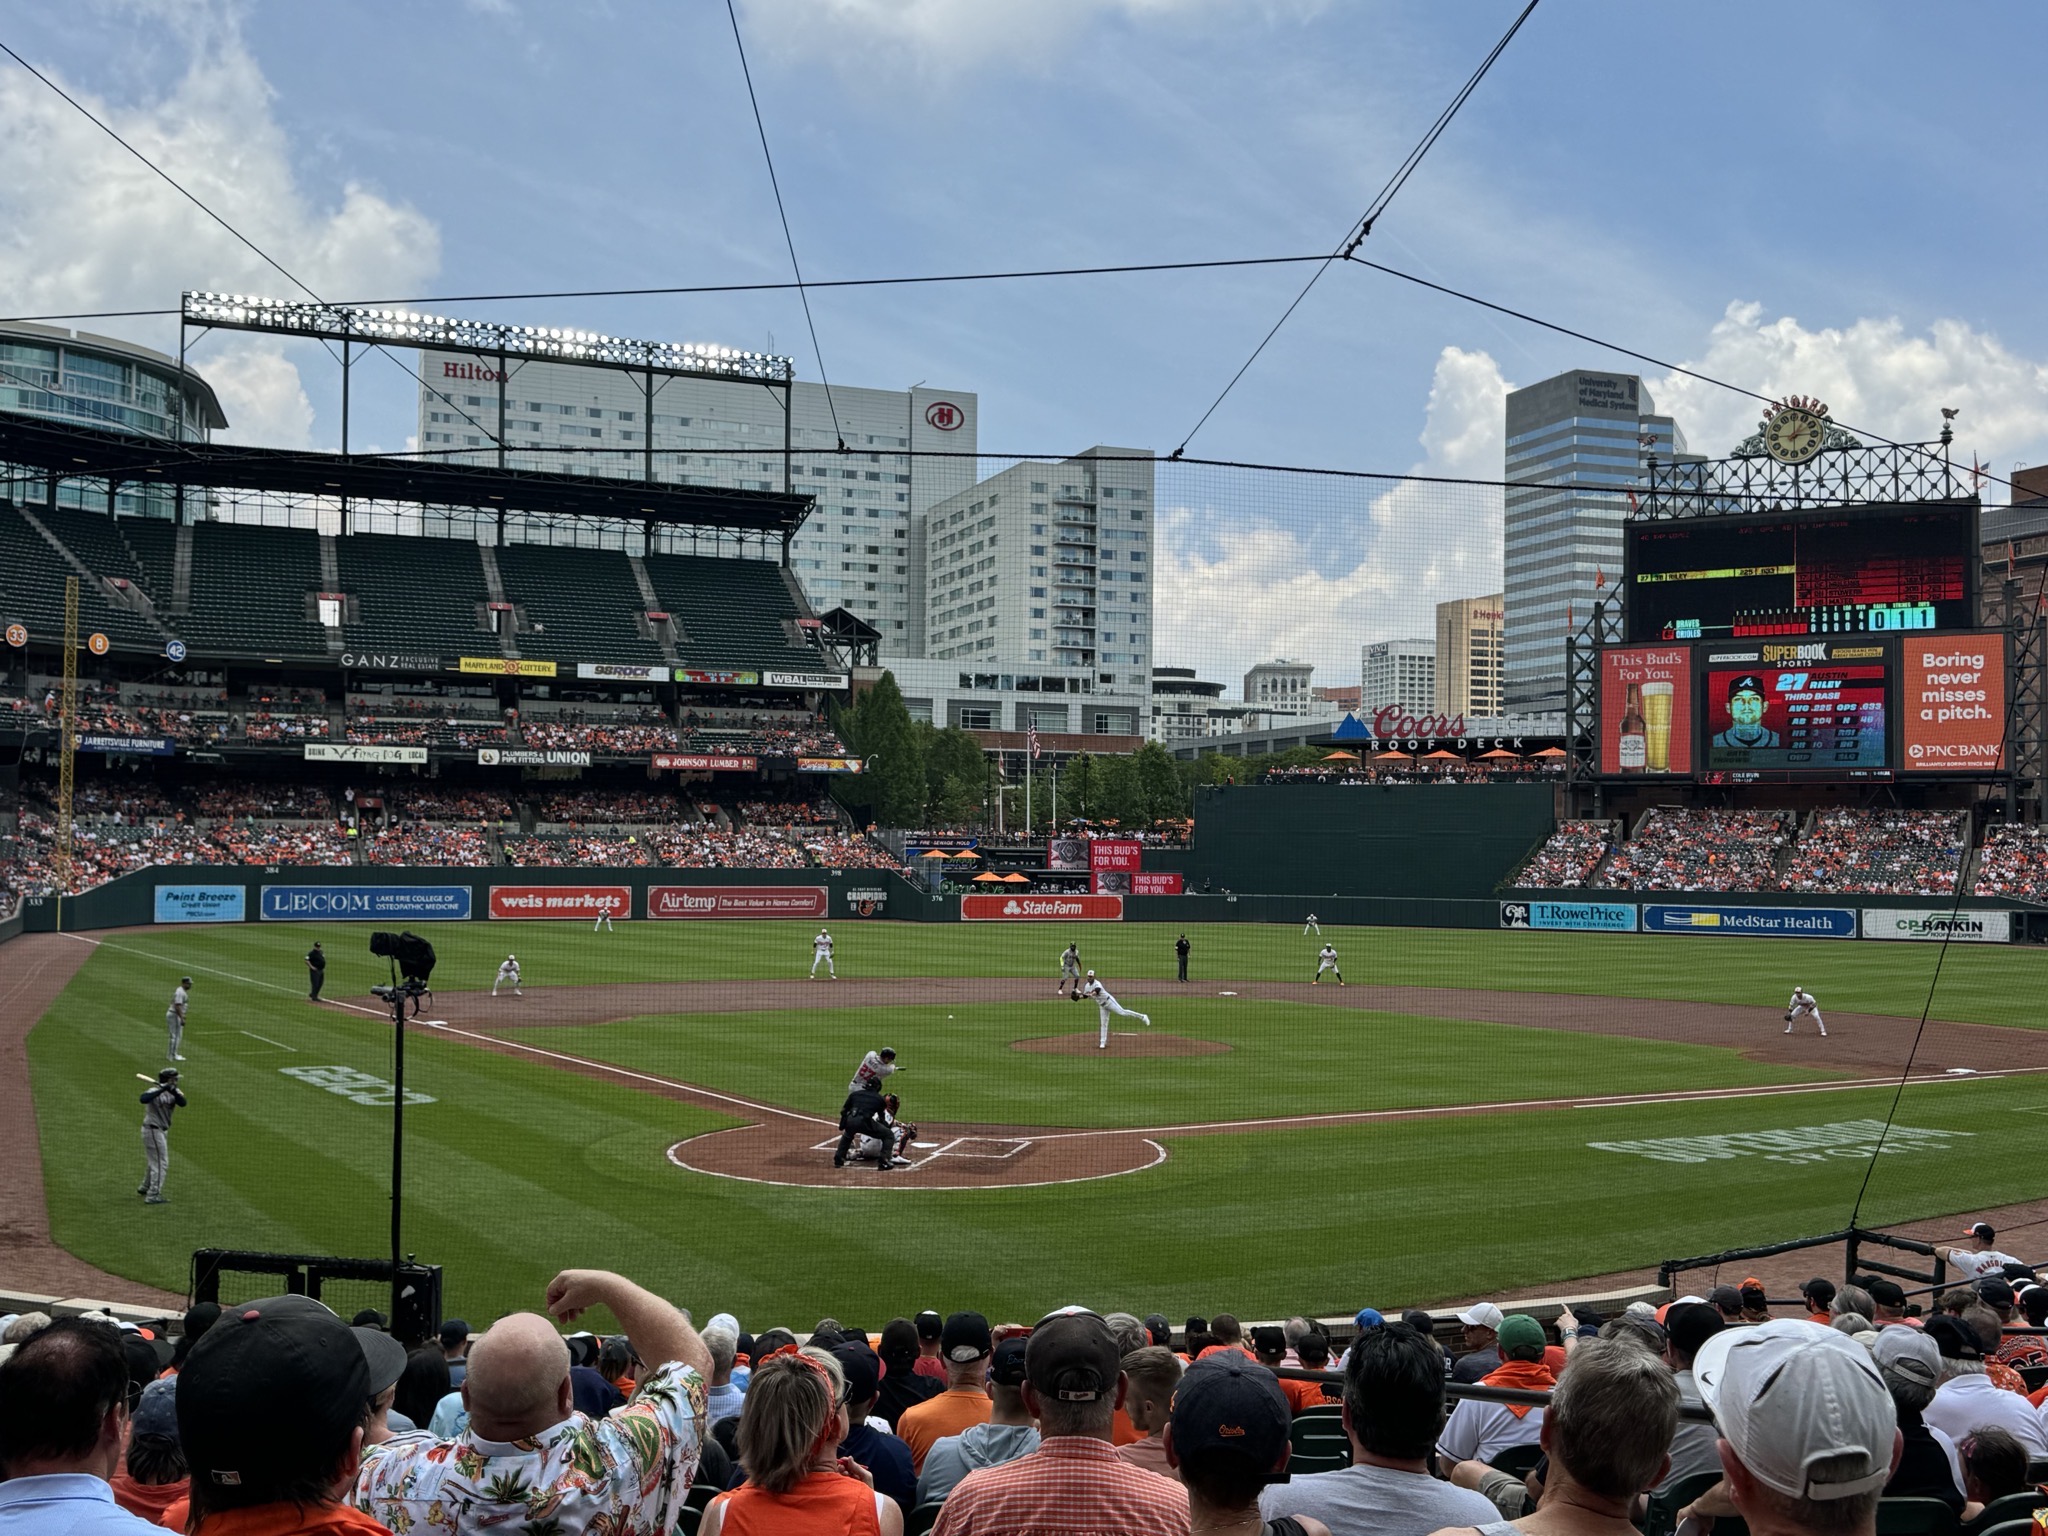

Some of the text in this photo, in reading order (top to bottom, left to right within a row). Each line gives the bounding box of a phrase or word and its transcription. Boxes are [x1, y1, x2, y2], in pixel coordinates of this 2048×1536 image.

[443, 361, 509, 383] Hilton
[1578, 376, 1618, 389] University
[1578, 387, 1624, 400] of Maryland
[1578, 397, 1637, 411] Medical System
[1480, 609, 1504, 620] Hopki
[1676, 611, 1864, 628] BRAVES 2 3 0 0 4
[1875, 611, 1885, 629] 0
[1898, 610, 1905, 628] 1
[1921, 609, 1927, 627] 1
[9, 629, 25, 642] 33
[1676, 622, 1864, 638] ORIOLES 0 0 0 0 4
[95, 639, 103, 650] 8
[169, 645, 183, 657] 42
[1763, 643, 1827, 662] SUPERBOOK
[341, 653, 400, 669] GANZ
[400, 657, 439, 665] EXCLUSIVE
[1610, 652, 1682, 667] This Bud's
[1777, 660, 1812, 668] SPORTS
[1922, 651, 1985, 669] Boring
[464, 661, 551, 673] MARYLAND LOTTERY
[1619, 667, 1674, 680] For You.
[772, 675, 806, 684] WBAL
[1775, 673, 1809, 691] 27
[1810, 672, 1848, 680] AUSTIN
[1927, 672, 1981, 685] never
[1809, 681, 1842, 690] RILEY
[1784, 692, 1840, 701] THIRD BASE
[1922, 687, 1986, 703] misses
[1788, 704, 1810, 712] AVG
[1836, 703, 1857, 711] OPS
[1920, 704, 1992, 723] a pitch.
[1372, 704, 1468, 738] Coors
[1791, 717, 1806, 725] AB
[84, 737, 130, 747] JARRETTSVILLE
[131, 739, 165, 749] FURNITURE
[1371, 738, 1523, 751] ROOF DECK
[308, 748, 325, 756] DRINK
[408, 751, 425, 759] LOCAL
[1926, 744, 2000, 757] PNC BANK
[546, 752, 590, 764] UNION
[672, 758, 707, 766] JOHNSON
[710, 759, 739, 768] LUMBER
[1093, 845, 1138, 855] THIS BUD'S
[1093, 856, 1130, 866] FOR YOU.
[1134, 876, 1173, 884] THIS BUD'S
[1134, 885, 1166, 894] FOR YOU.
[198, 893, 236, 901] Breeze
[501, 894, 621, 908] weis markets
[660, 892, 716, 911] Airtemp
[722, 898, 733, 906] The
[733, 898, 747, 906] Best
[749, 898, 765, 906] Value
[847, 892, 887, 901] CHAMPIONS
[1722, 915, 1832, 930] MedStar Health
[1921, 921, 1982, 933] RANKIN
[859, 1062, 877, 1080] 27
[1976, 1260, 2004, 1274] MANSOL
